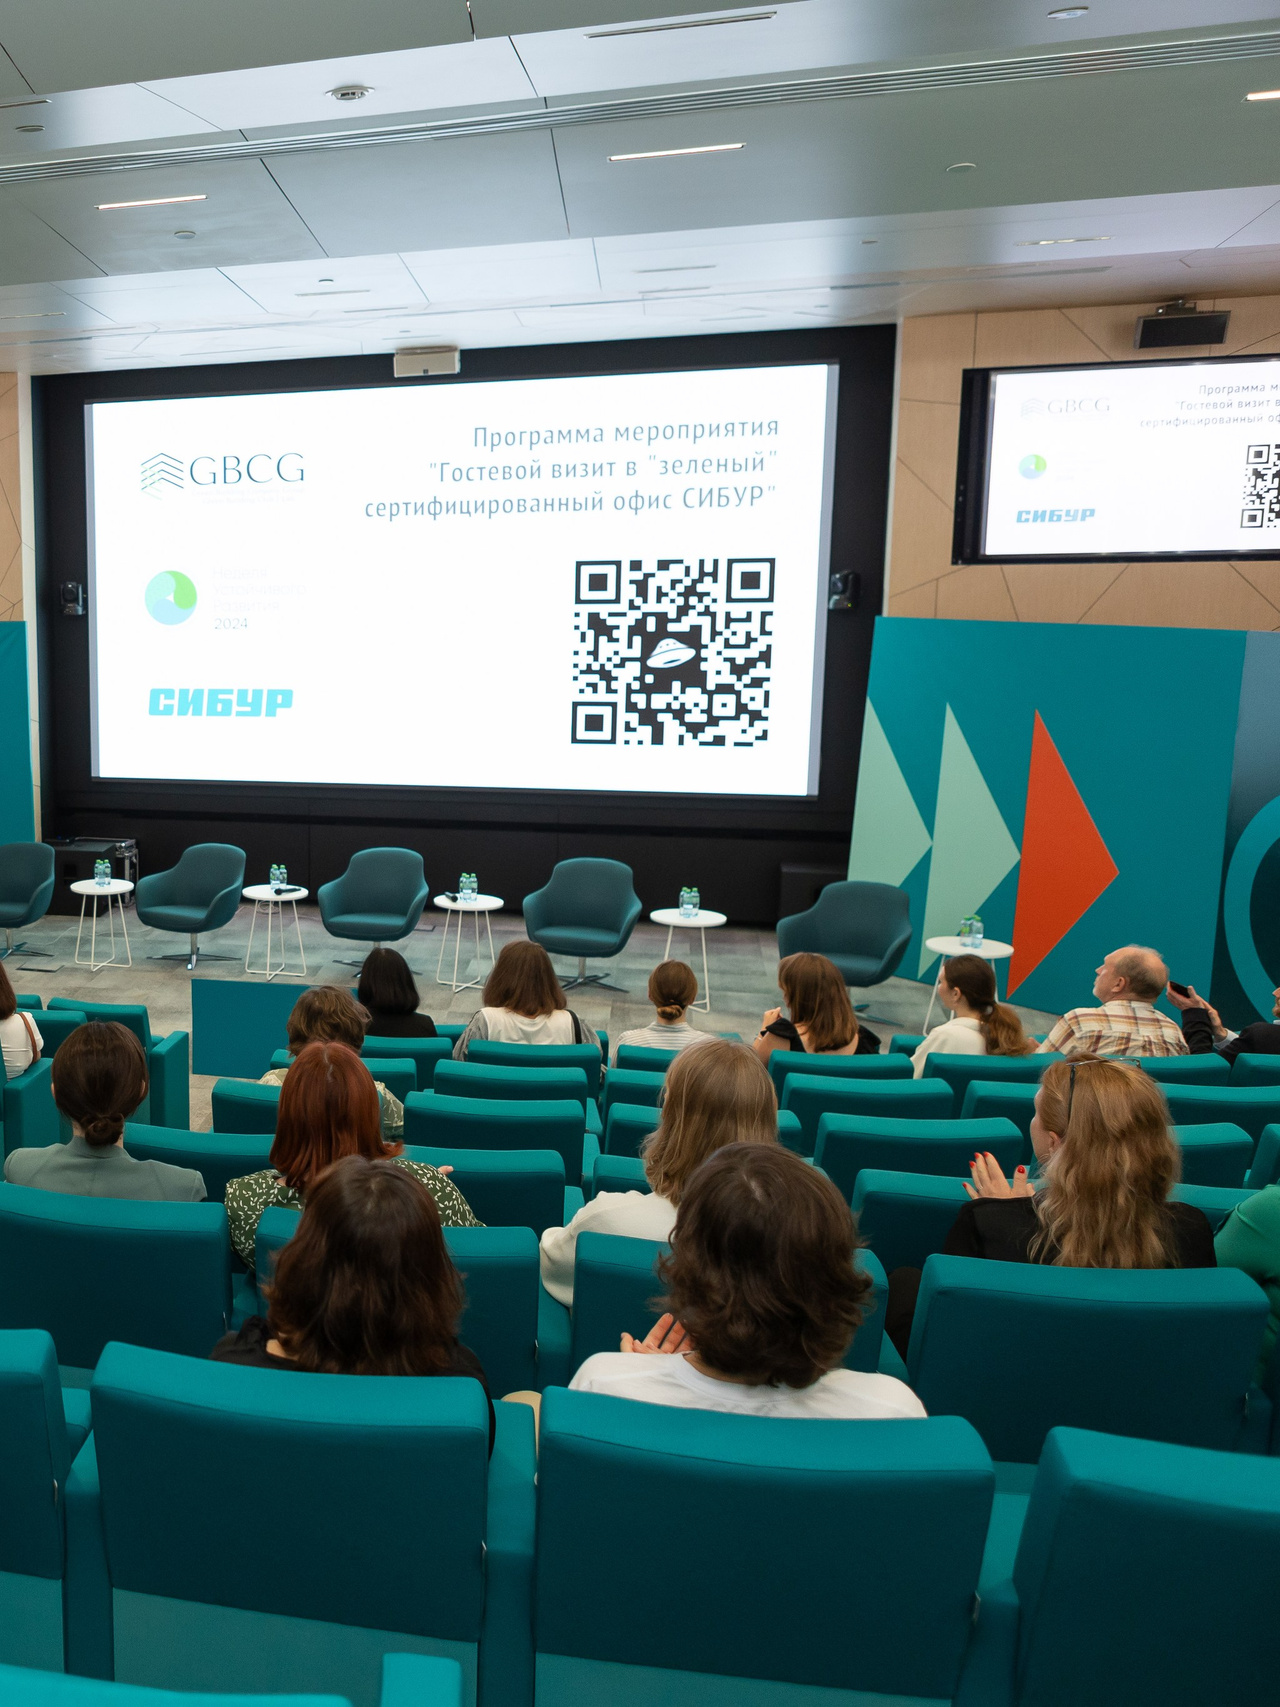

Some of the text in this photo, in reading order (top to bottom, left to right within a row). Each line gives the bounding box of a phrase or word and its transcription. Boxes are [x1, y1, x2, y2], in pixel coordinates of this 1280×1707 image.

[1199, 384, 1266, 396] Программа
[1047, 397, 1110, 414] GBCG
[1237, 399, 1271, 409] визит
[1140, 413, 1263, 428] сертифицированный
[473, 420, 779, 452] Программа мероприятия
[189, 452, 305, 486] GBCG
[429, 451, 777, 482] "Гостевой визит в "зеленый"
[365, 485, 776, 522] сертифицированный офис СИБУР"
[1016, 508, 1096, 523] СИБУР
[214, 617, 248, 630] 2024
[148, 688, 294, 718] СИБУР
